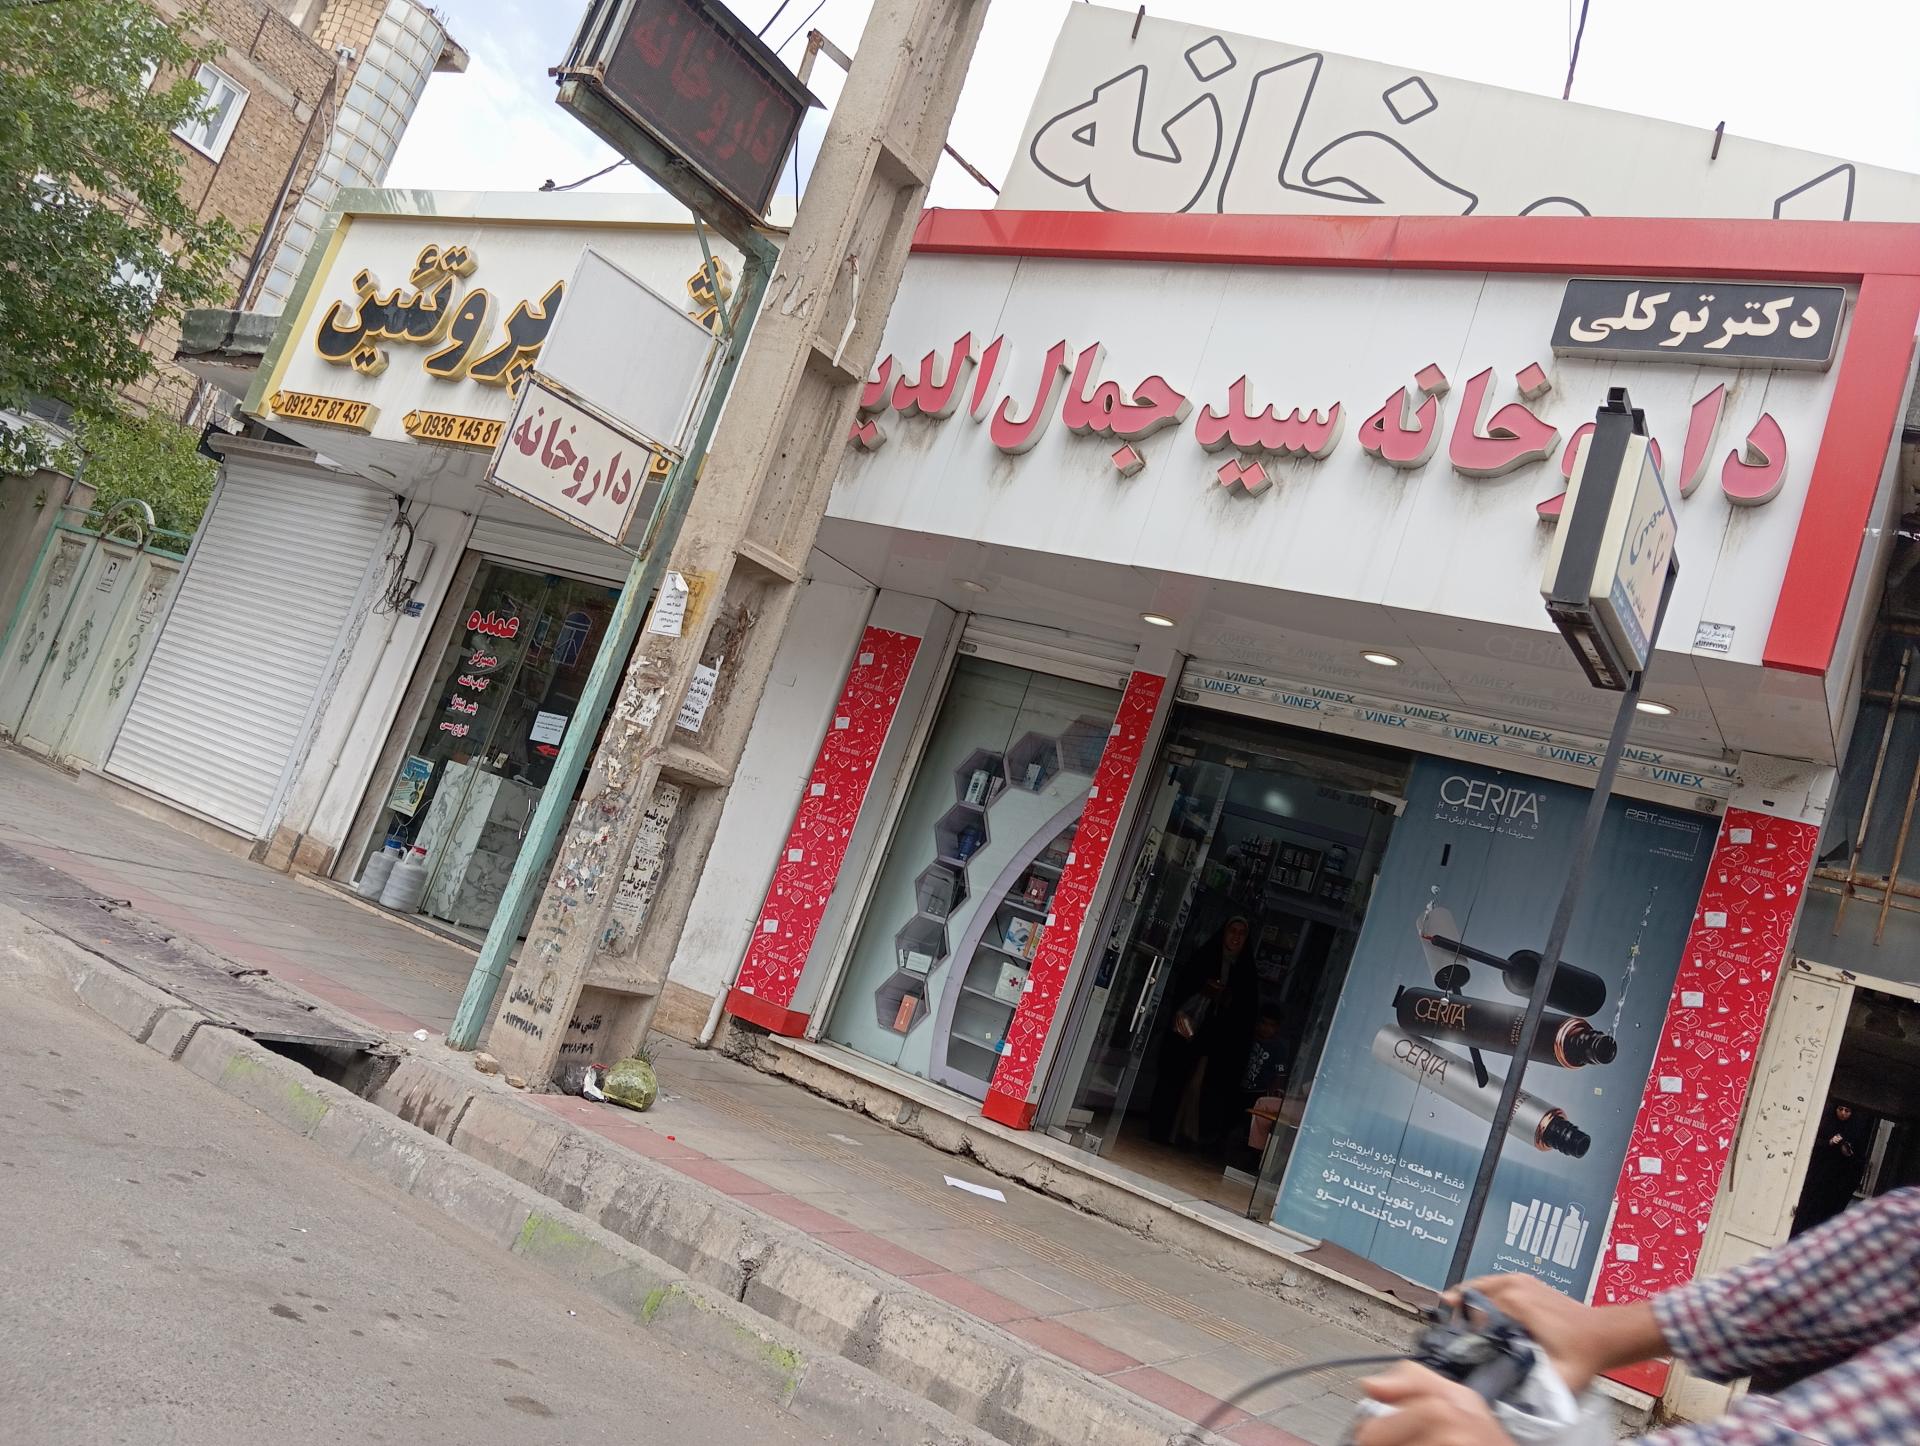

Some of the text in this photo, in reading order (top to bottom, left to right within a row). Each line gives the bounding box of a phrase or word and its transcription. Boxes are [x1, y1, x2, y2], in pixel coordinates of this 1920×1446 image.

[1569, 289, 1822, 351] دکتر توکلی
[284, 393, 368, 424] 0912 57 87 437
[421, 414, 455, 438] 0936
[458, 419, 481, 442] 145
[988, 339, 1194, 479] جمال
[513, 408, 632, 507] داروخانه
[1194, 374, 1346, 498] سید
[466, 610, 520, 639] عمده
[1203, 679, 1241, 695] VINEX
[1282, 694, 1321, 711] VINEX
[1364, 710, 1408, 728] VINEX
[1453, 728, 1500, 746] VINEX
[1549, 747, 1598, 767] VINEX
[1652, 767, 1705, 789] VINEX
[1225, 671, 1664, 765] VINEX VINEX VINEX VINEX INEX
[1440, 775, 1540, 824] CERITA
[1415, 997, 1466, 1027] CERITA
[1394, 1038, 1449, 1081] CERITA
[1332, 1137, 1466, 1190] فقط ۴ هفته تا مژه و ابروهایی
[1315, 1187, 1350, 1207] ابرو
[1322, 1168, 1455, 1227] محلول تقویت کننده مژه
[1411, 1224, 1448, 1245] سرم
[1496, 1252, 1530, 1268] تخصصی
[1530, 1264, 1545, 1277] برند
